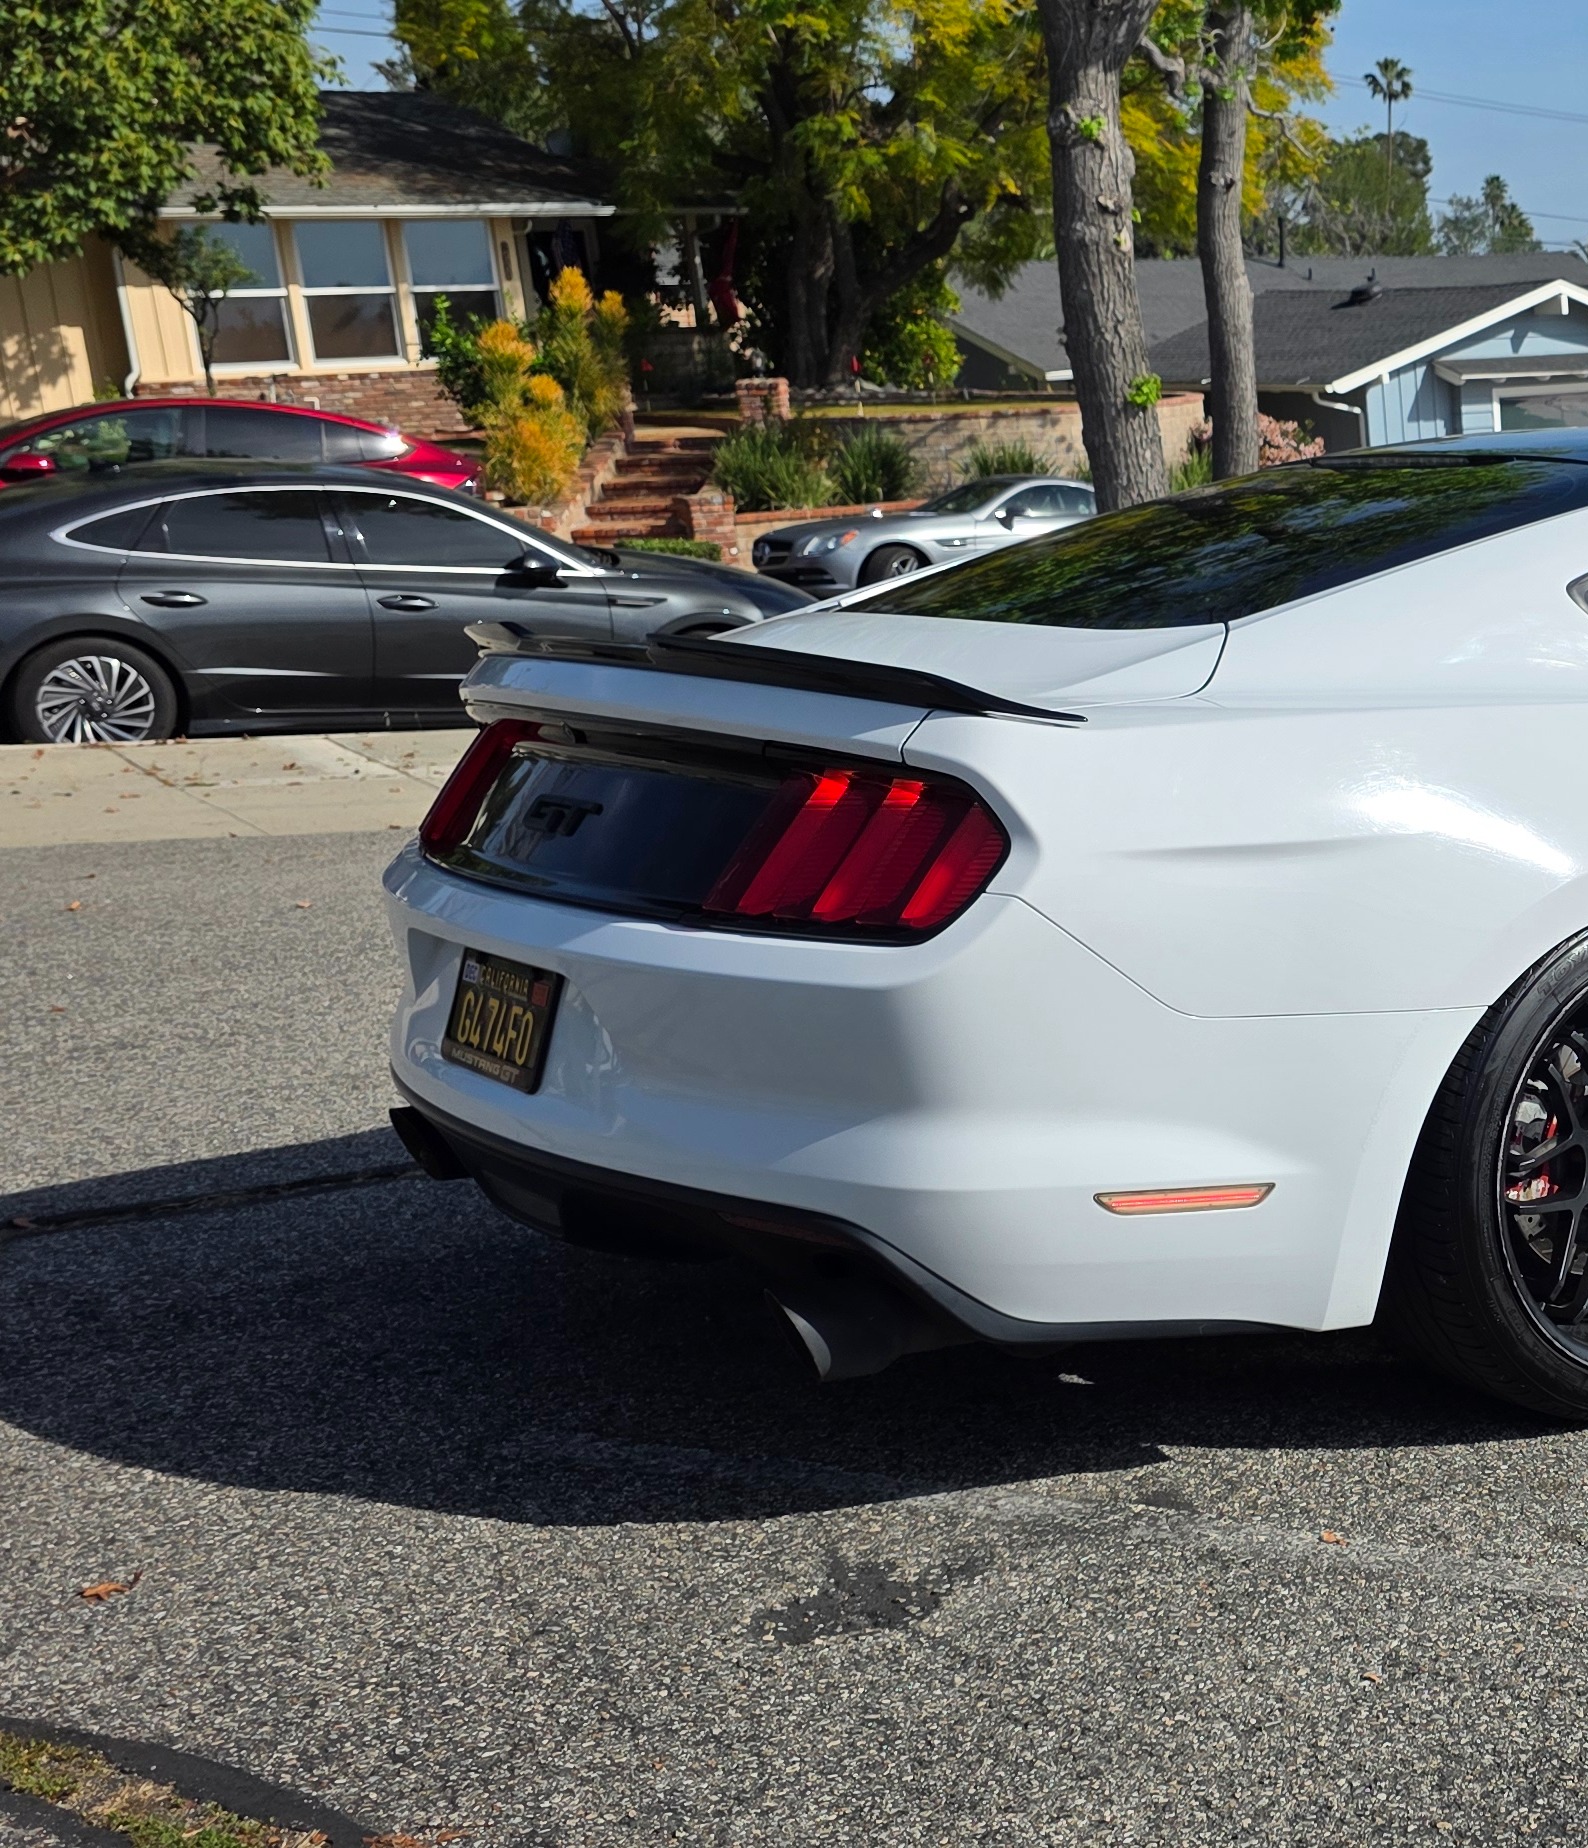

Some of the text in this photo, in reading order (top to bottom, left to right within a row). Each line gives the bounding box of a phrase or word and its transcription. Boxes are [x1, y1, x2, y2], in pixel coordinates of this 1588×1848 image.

[521, 794, 604, 838] GT
[480, 965, 529, 995] CALIFORNIA
[451, 1048, 520, 1084] MUSTANG GT
